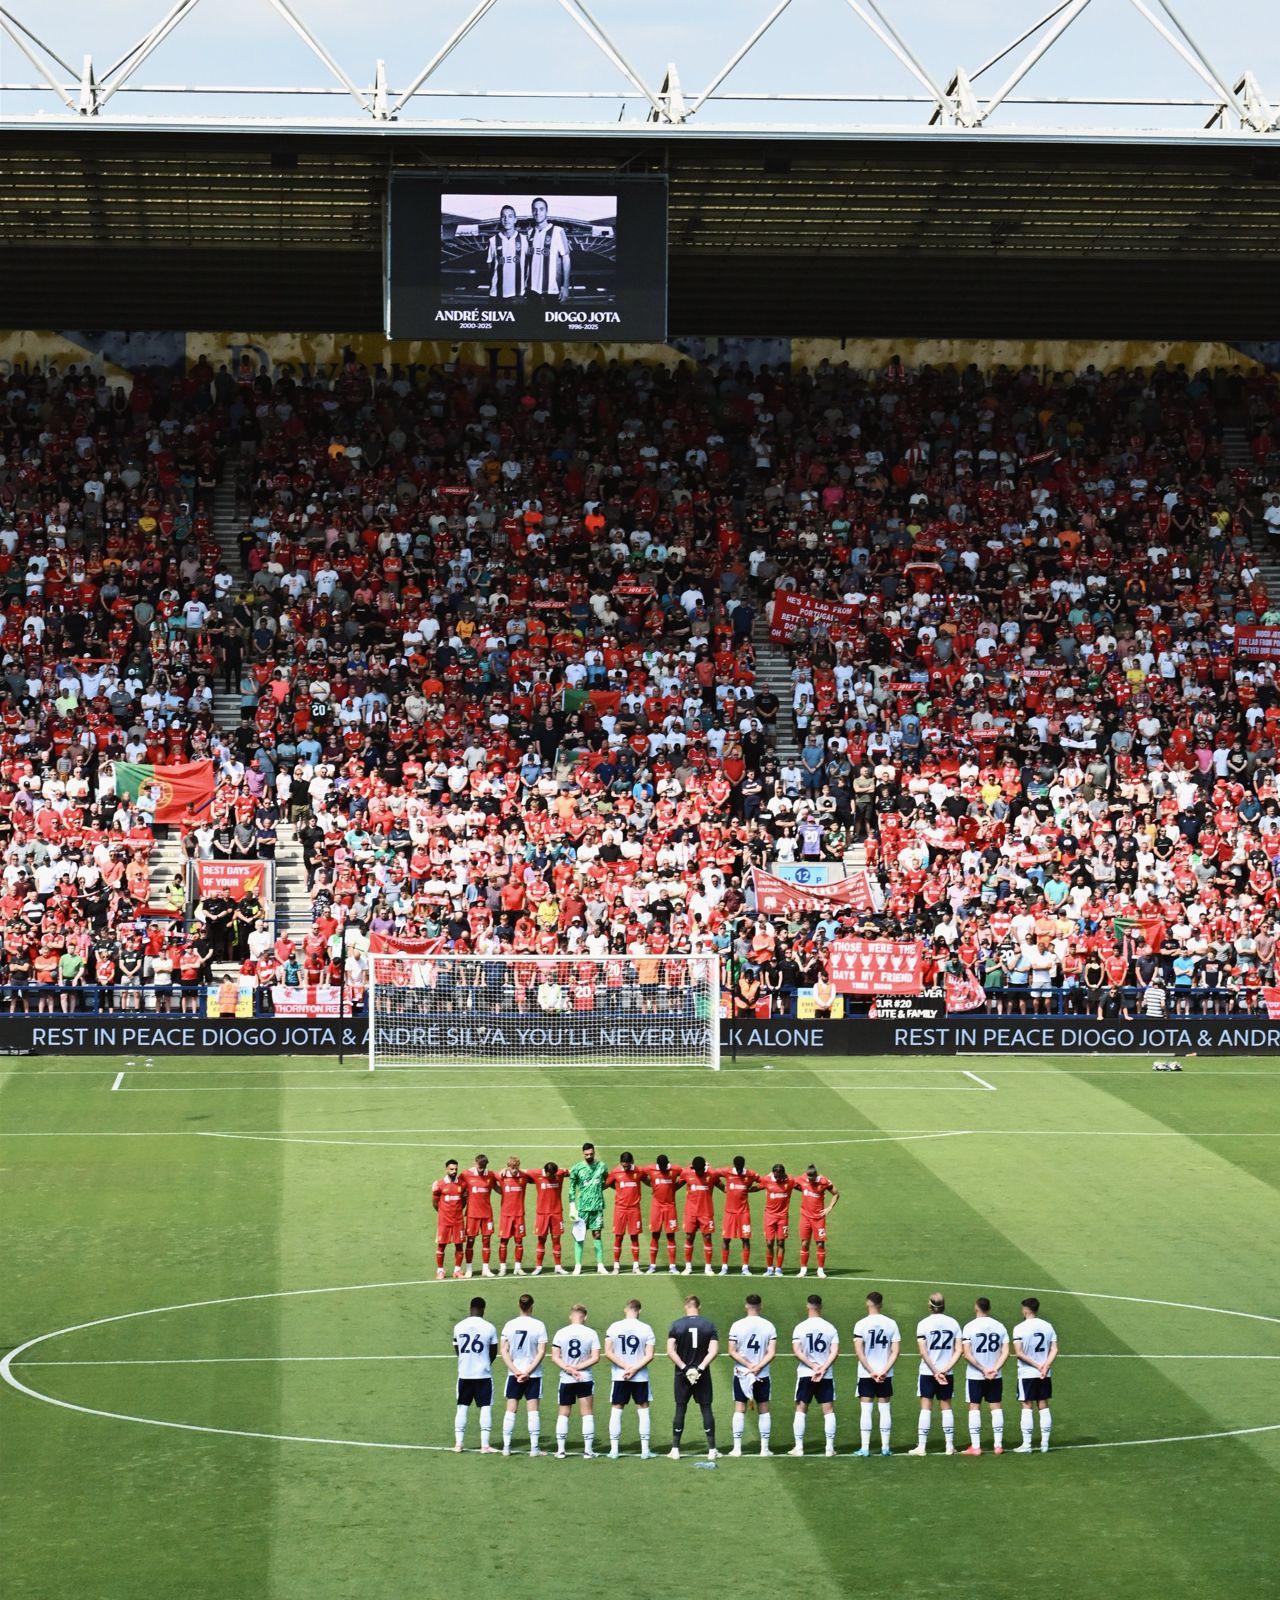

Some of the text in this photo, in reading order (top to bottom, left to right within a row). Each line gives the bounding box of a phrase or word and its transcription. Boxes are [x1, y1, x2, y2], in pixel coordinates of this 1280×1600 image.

[434, 308, 516, 322] ANDRÉ SILVA
[545, 311, 621, 323] DIOGO JOTA
[805, 600, 811, 608] A
[814, 602, 829, 611] LAD
[832, 606, 853, 615] FROM
[1238, 637, 1248, 645] THE
[1248, 638, 1258, 646] LAD
[312, 704, 326, 716] 20
[804, 830, 818, 843] 20
[202, 866, 250, 875] BEST DAYS
[796, 871, 809, 880] 12
[202, 877, 239, 887] OF YOUR
[832, 942, 916, 955] THOSE WERE THE
[832, 970, 913, 982] DAYS MY FRIEND
[574, 985, 592, 998] 20
[275, 1004, 324, 1013] THORNTON
[893, 999, 912, 1009] #20
[897, 1009, 906, 1018] &
[906, 1009, 938, 1018] FAMILY
[32, 1028, 88, 1046] REST
[95, 1028, 116, 1046] IN
[123, 1028, 196, 1046] PEACE
[203, 1028, 277, 1046] DIOGO
[281, 1028, 336, 1046] JOTA
[342, 1028, 356, 1045] &
[600, 1028, 675, 1046] NEVER
[747, 1029, 824, 1047] ALONE
[895, 1029, 949, 1046] REST
[955, 1029, 976, 1046] IN
[984, 1029, 1055, 1046] PEACE
[1061, 1029, 1135, 1047] DIOGO
[1140, 1029, 1193, 1047] JOTA
[1197, 1029, 1213, 1047] &
[459, 1333, 484, 1354] 26
[515, 1330, 528, 1350] 7
[618, 1334, 640, 1355] 19
[688, 1327, 698, 1348] 1
[746, 1333, 760, 1351] 4
[806, 1333, 827, 1353] 16
[868, 1329, 889, 1349] 14
[929, 1330, 954, 1351] 22
[975, 1333, 1000, 1353] 28
[1034, 1332, 1046, 1352] 2
[568, 1338, 581, 1359] 8
